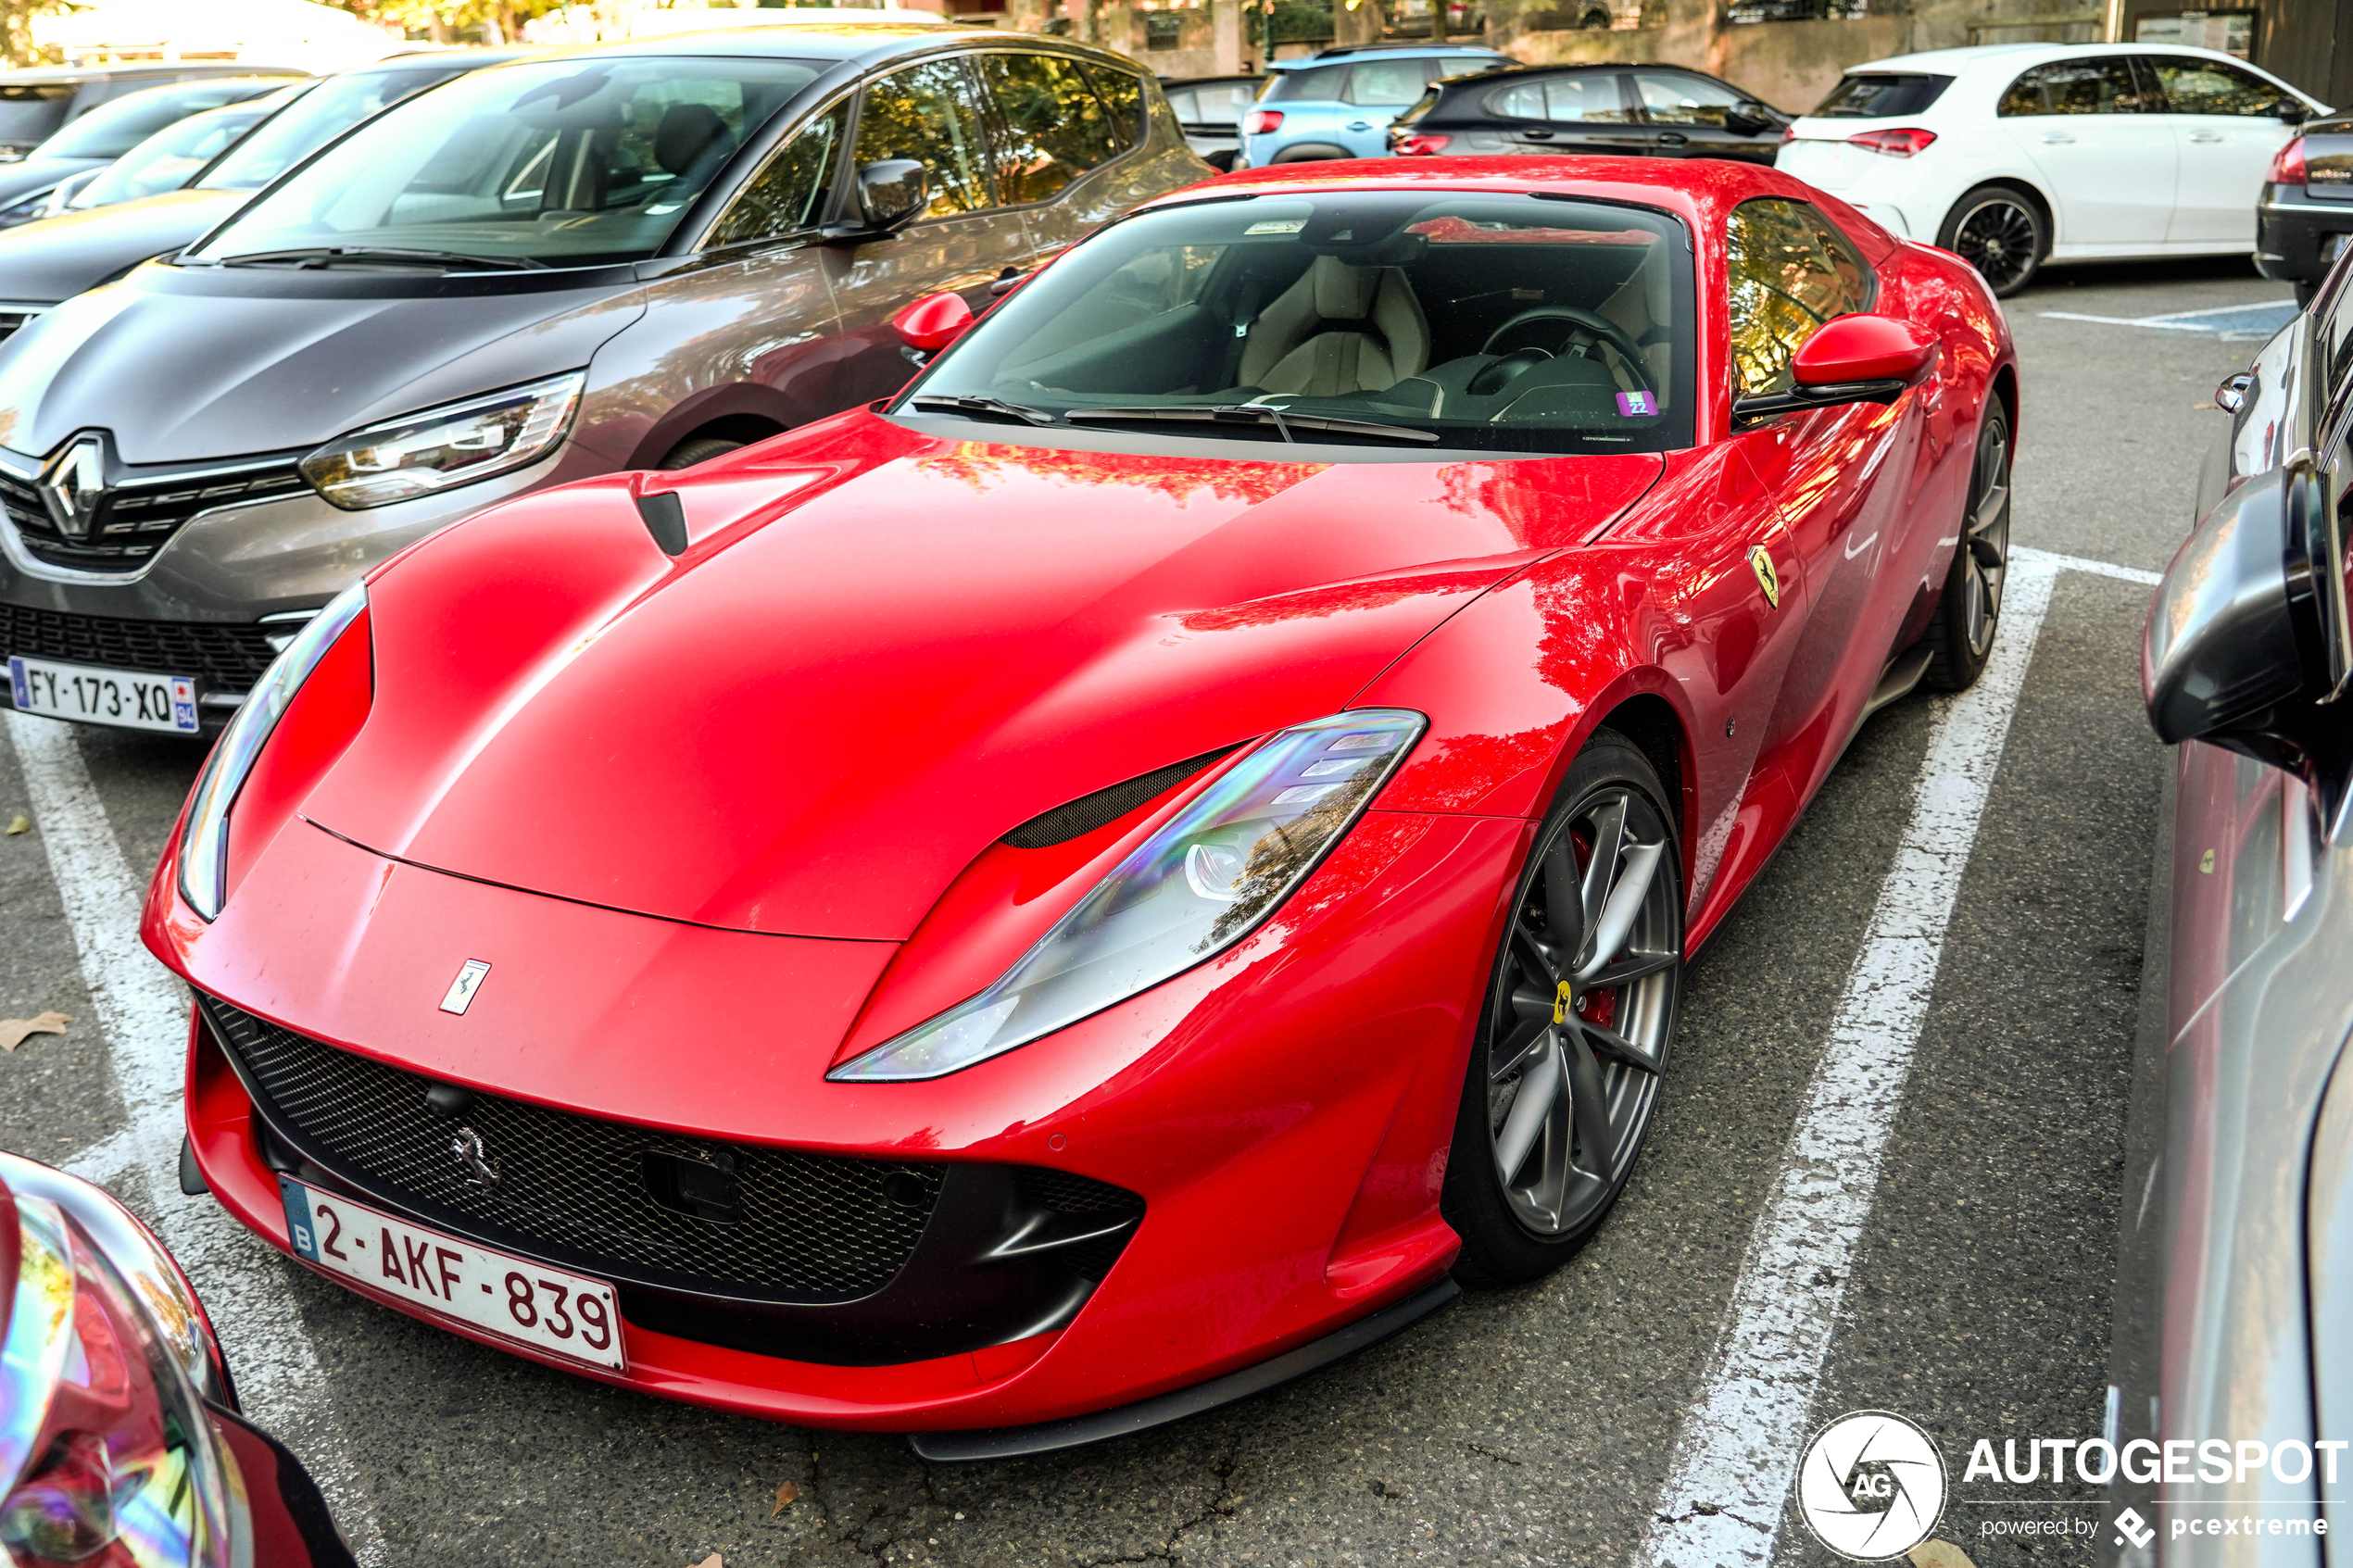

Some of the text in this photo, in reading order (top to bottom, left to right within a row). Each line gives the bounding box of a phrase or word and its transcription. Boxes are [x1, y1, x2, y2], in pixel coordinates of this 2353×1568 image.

[1629, 402, 1648, 413] 22
[30, 670, 171, 721] FY-173-XQ
[178, 706, 195, 723] 94
[295, 1223, 312, 1251] B
